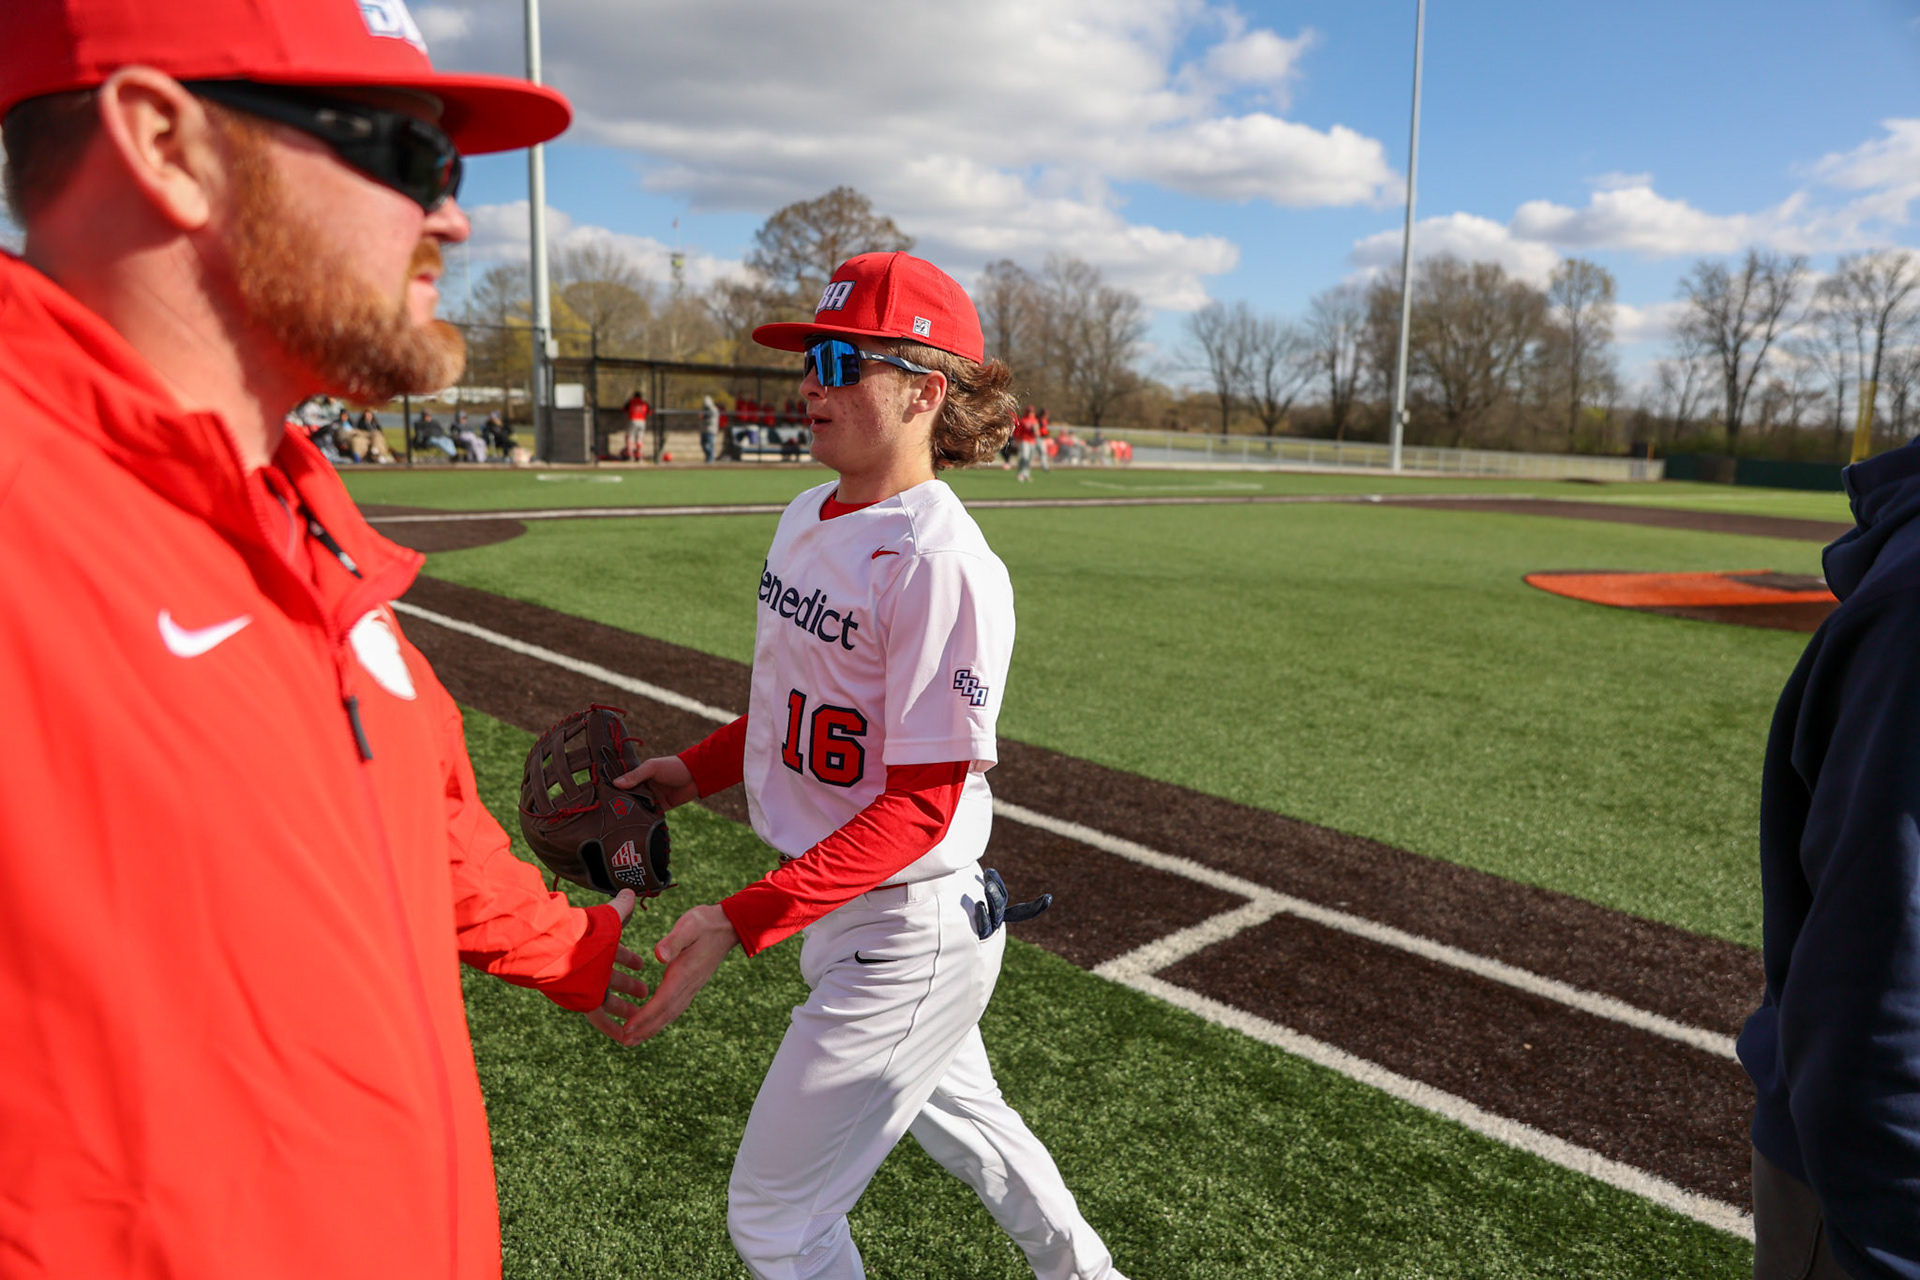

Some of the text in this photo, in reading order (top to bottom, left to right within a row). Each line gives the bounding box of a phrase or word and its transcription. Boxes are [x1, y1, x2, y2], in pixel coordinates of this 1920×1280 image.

[759, 559, 859, 650] enedict
[953, 669, 988, 706] SBA
[782, 688, 867, 787] 16
